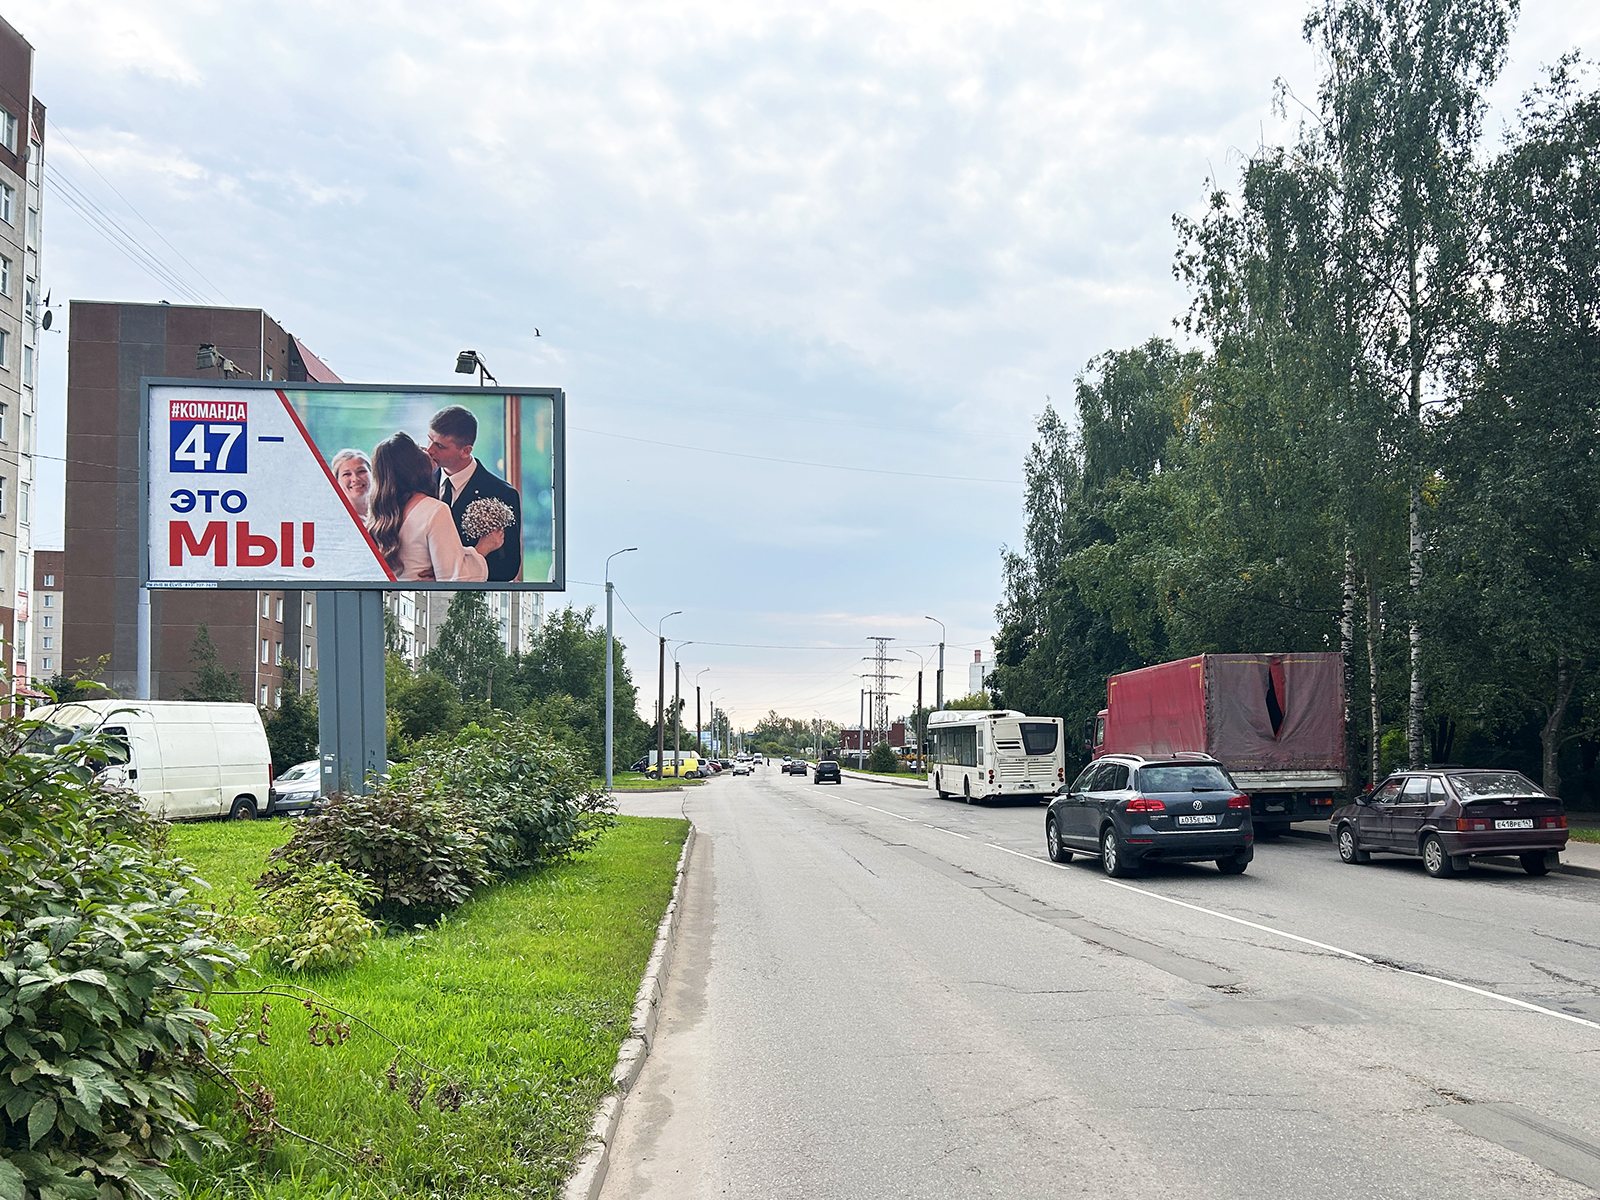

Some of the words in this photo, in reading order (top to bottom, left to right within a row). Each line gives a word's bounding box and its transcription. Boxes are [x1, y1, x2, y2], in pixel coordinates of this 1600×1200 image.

[171, 402, 246, 421] #КОМАНДА
[174, 424, 243, 471] 47
[169, 520, 316, 569] МЫ!
